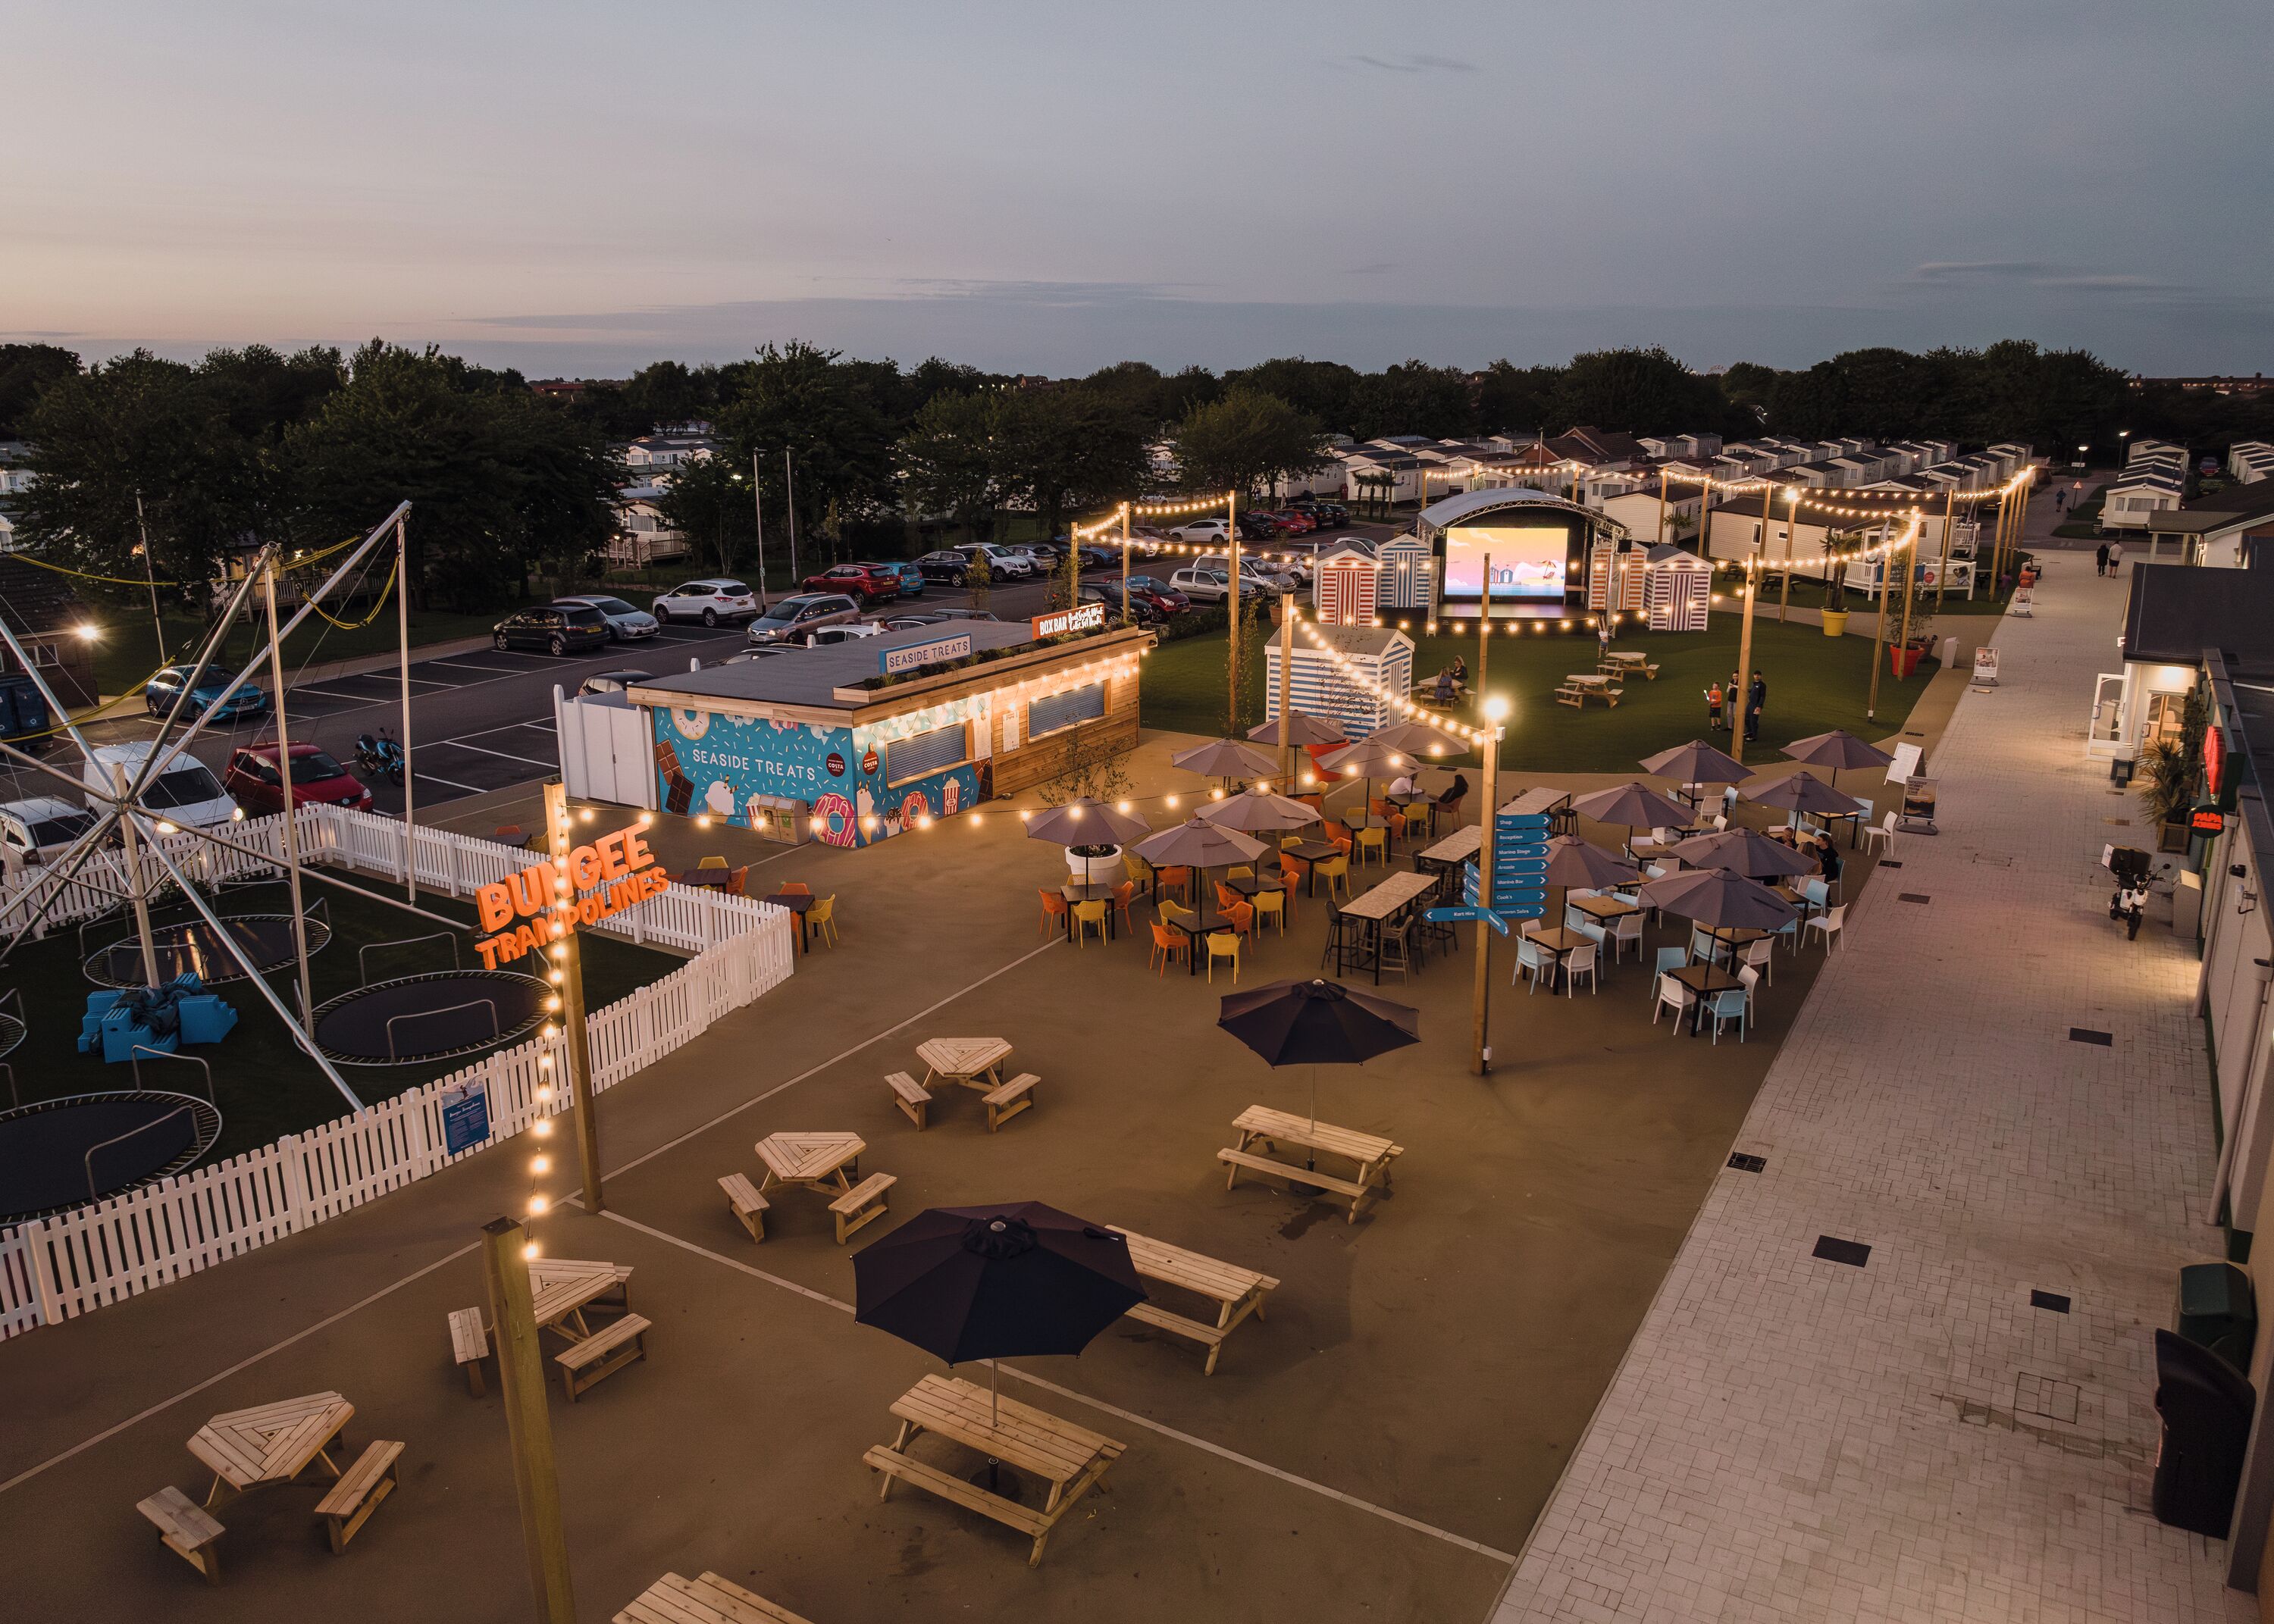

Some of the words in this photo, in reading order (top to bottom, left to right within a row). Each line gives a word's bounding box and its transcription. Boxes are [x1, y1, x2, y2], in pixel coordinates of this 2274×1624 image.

[1039, 618, 1054, 636] BOX
[1054, 616, 1067, 632] BAR
[889, 649, 928, 668] SEASIDE
[932, 641, 968, 659] TREATS
[692, 749, 750, 771] SEASIDE
[755, 759, 816, 781] TREATS
[864, 760, 878, 768] COSTA
[2194, 812, 2222, 823] PAPA
[475, 822, 655, 934] BUNGEE
[475, 865, 669, 970] TRAMPOLINES
